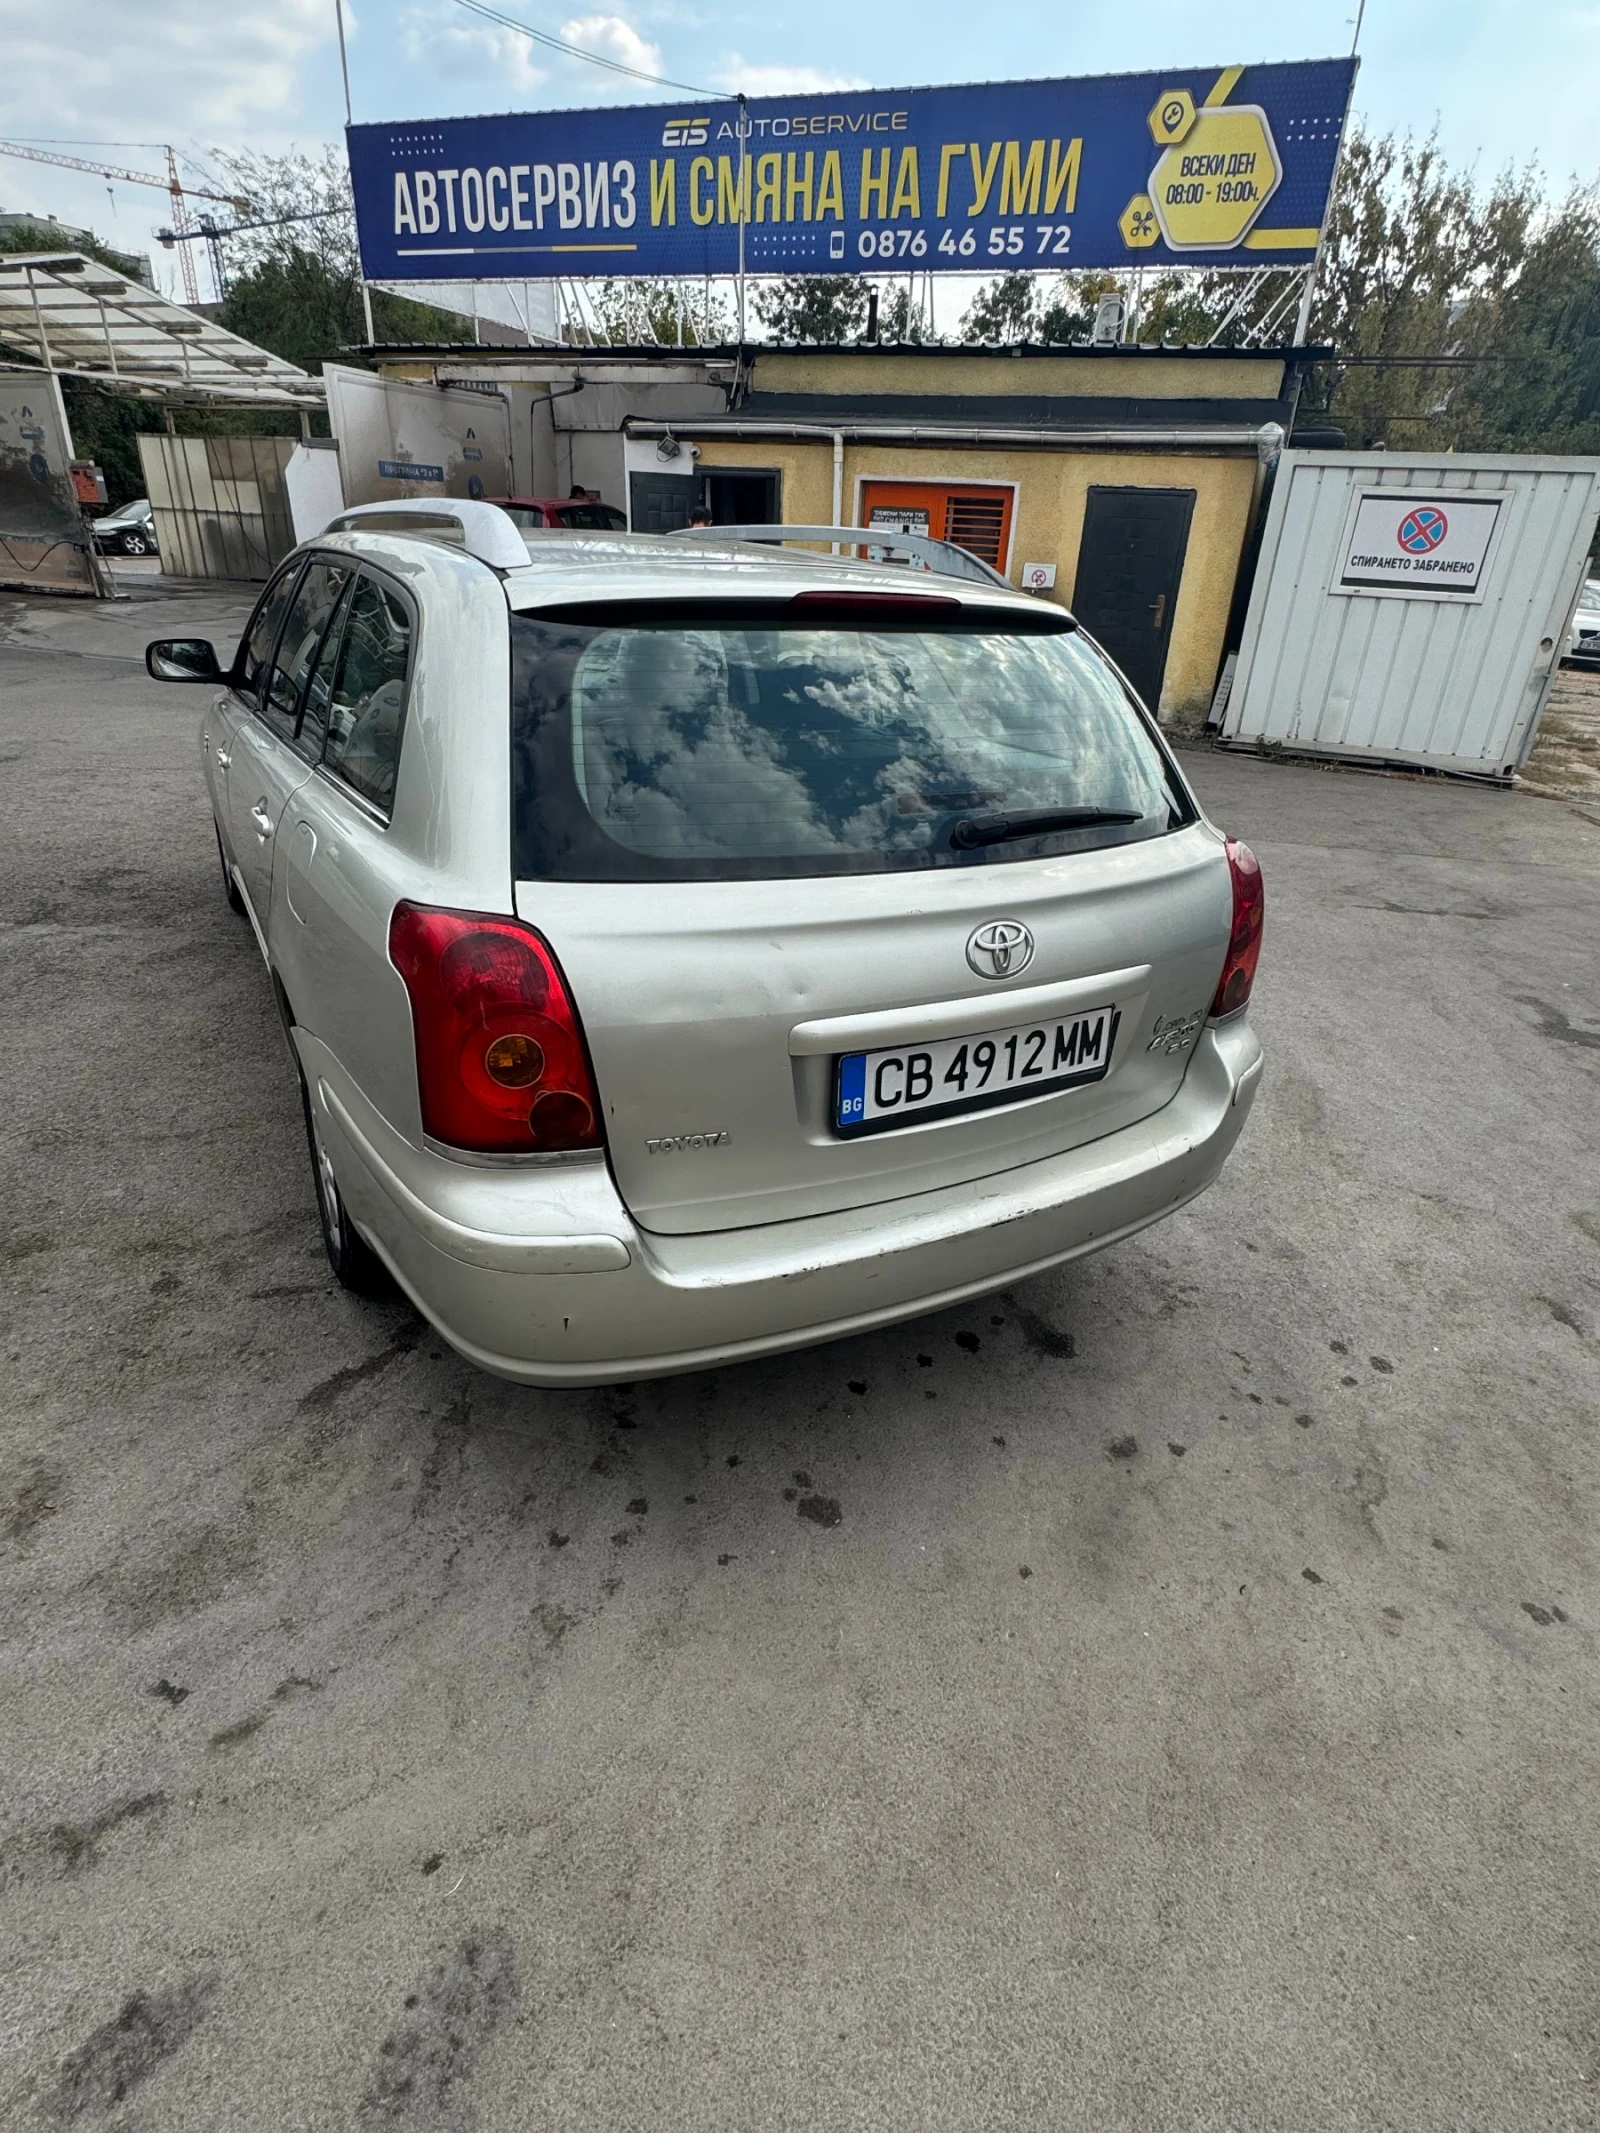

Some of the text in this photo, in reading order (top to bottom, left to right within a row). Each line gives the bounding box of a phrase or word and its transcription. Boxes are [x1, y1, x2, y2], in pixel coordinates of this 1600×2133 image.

[716, 111, 909, 140] AUTOSERVICE
[1180, 152, 1257, 178] ВСЕКИ ДЕН
[394, 137, 1083, 235] АВТОСЕРВИЗ И СМЯНА НА ГУМИ
[1165, 183, 1205, 205] 08:00
[858, 225, 1071, 258] 0876 46 55 72
[884, 516, 914, 525] CHANGE
[1350, 555, 1475, 574] СПИРАНЕТО ЗАБРАНЕНО
[842, 1097, 863, 1115] BG
[874, 1052, 934, 1109] CB
[944, 1029, 1047, 1092] 4912
[1051, 1016, 1105, 1071] MM
[644, 1131, 732, 1155] TOYOTA
